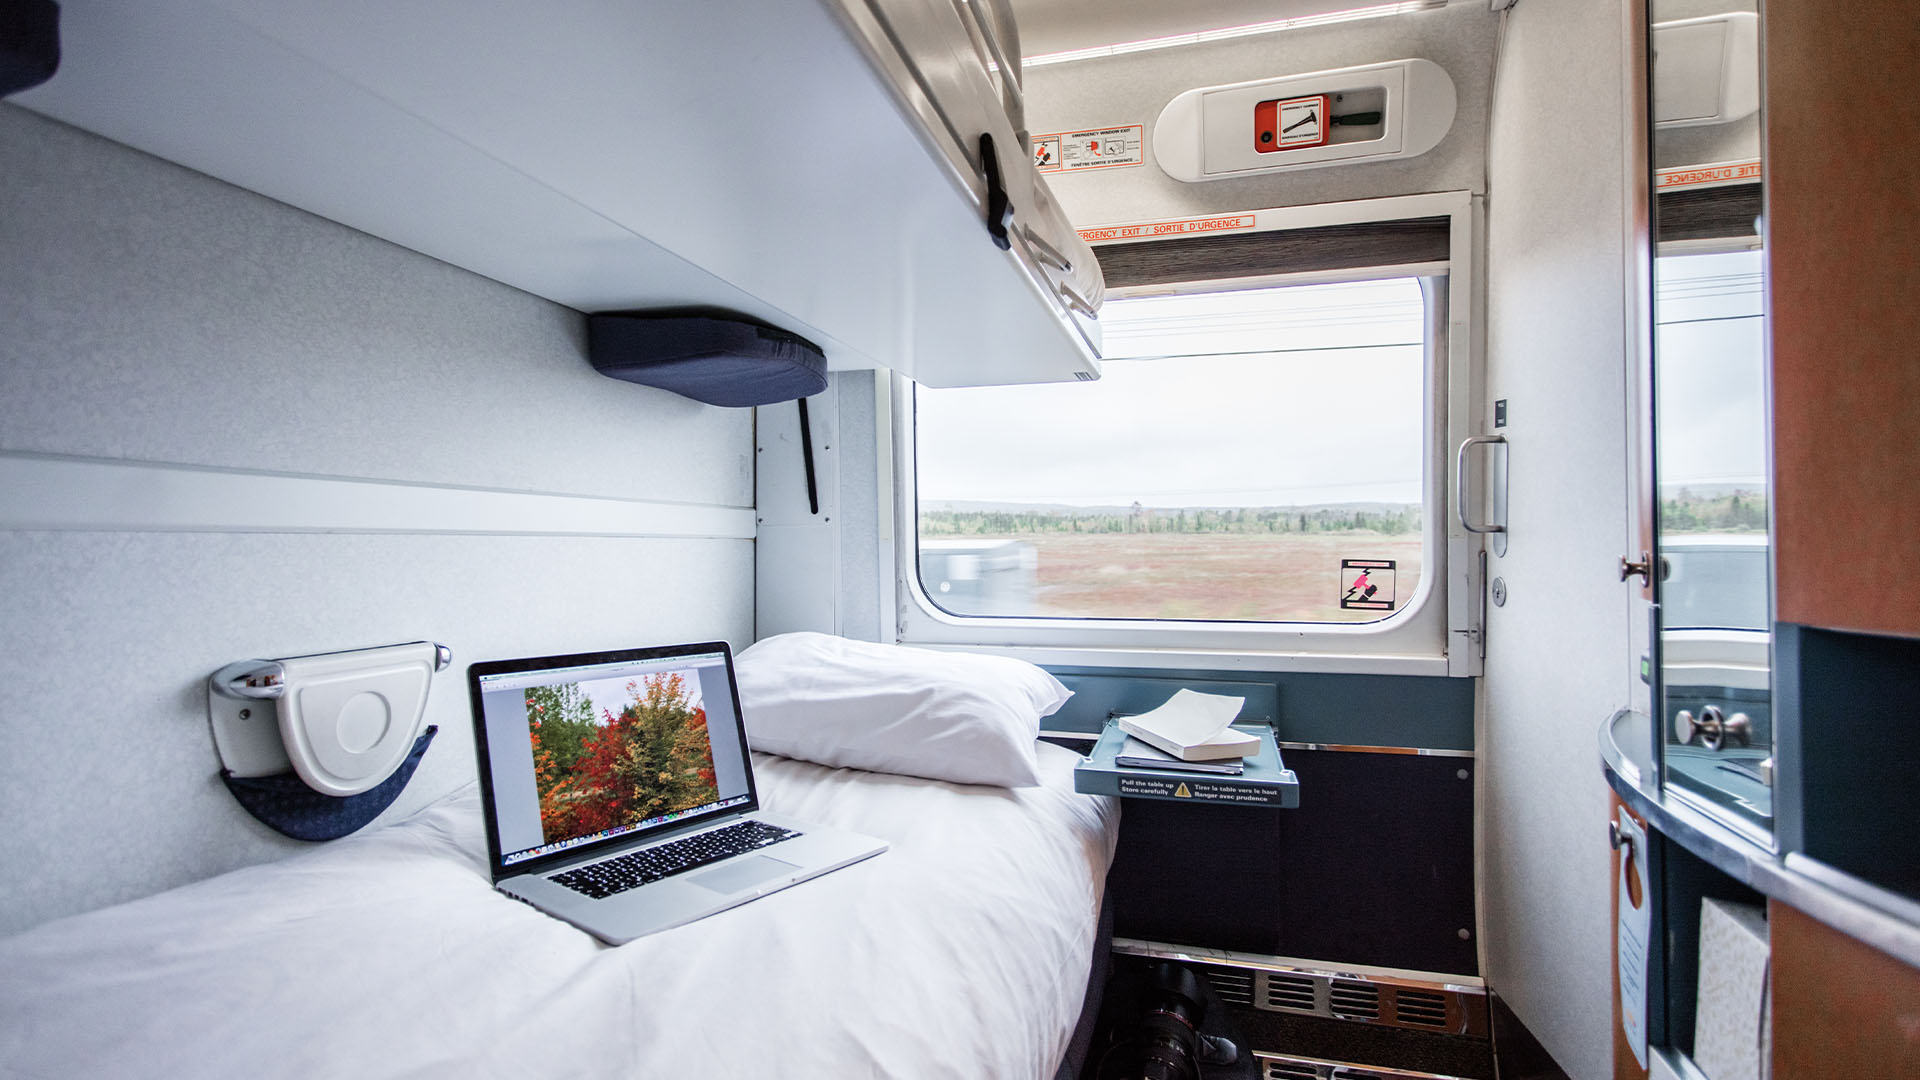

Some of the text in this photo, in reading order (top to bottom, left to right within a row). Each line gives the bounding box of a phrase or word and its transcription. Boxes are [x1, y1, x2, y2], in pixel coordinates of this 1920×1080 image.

[1122, 228, 1140, 237] EXIT
[1153, 224, 1185, 234] SORTIE
[1189, 218, 1241, 231] D'URGENCE
[1140, 788, 1169, 796] carefully
[1194, 791, 1218, 799] Ranger
